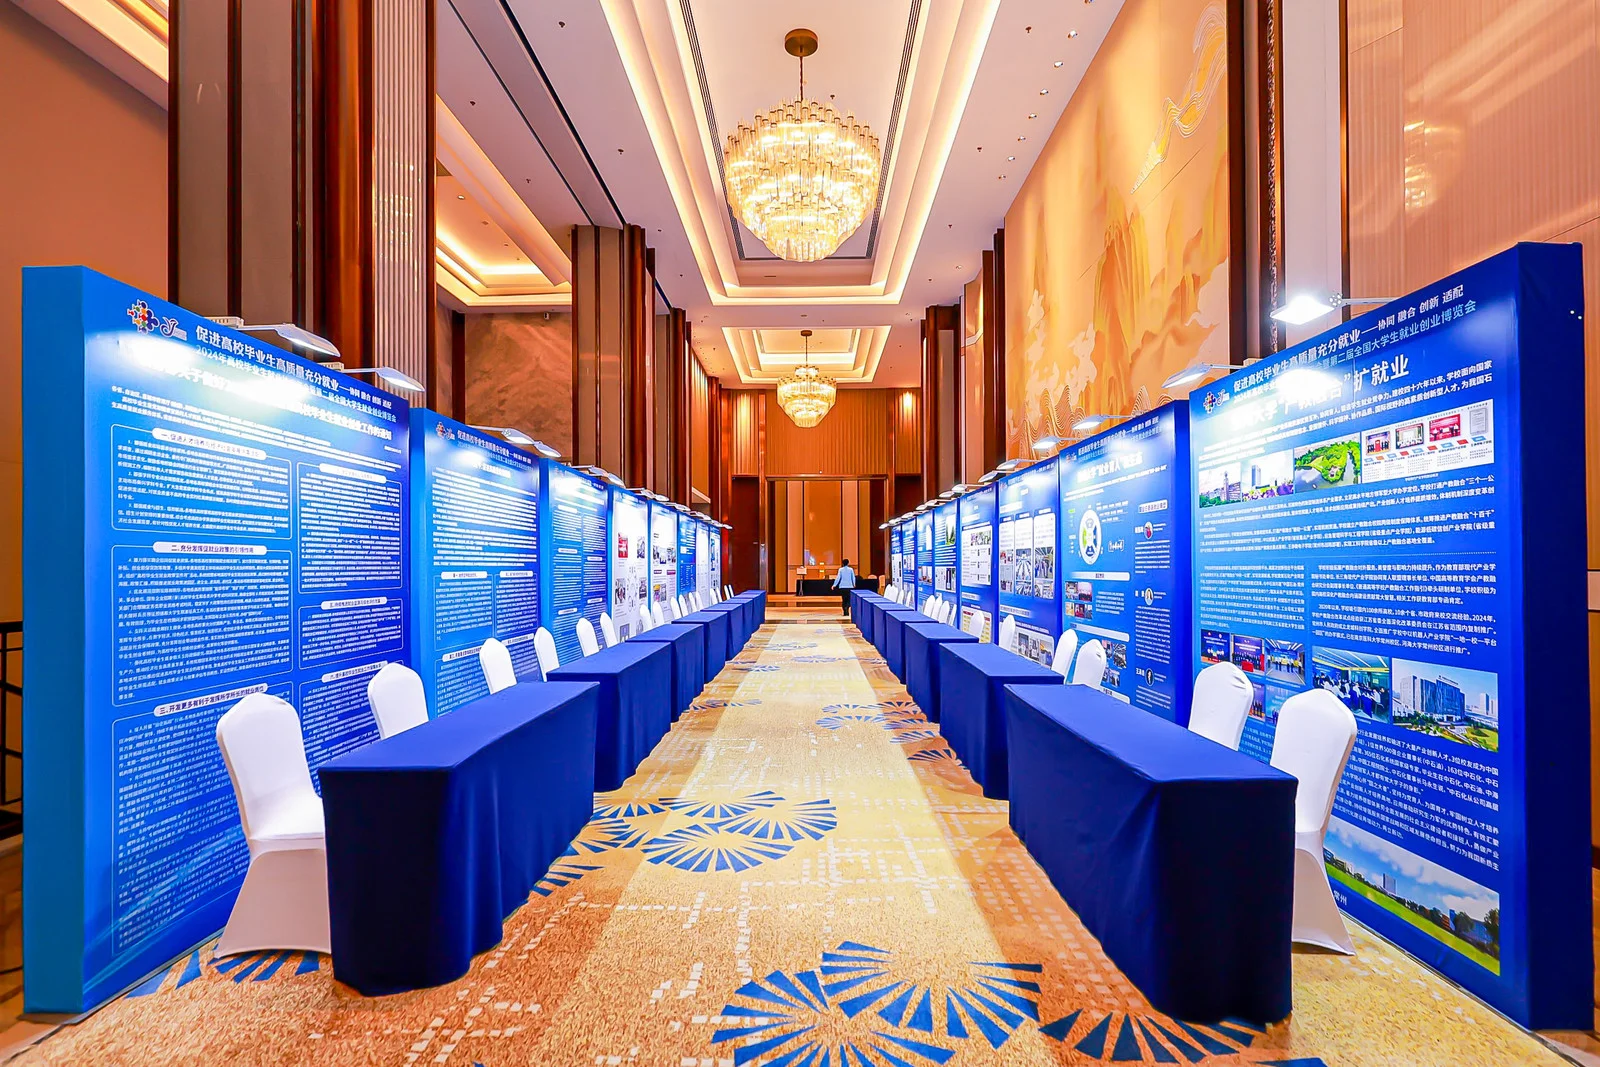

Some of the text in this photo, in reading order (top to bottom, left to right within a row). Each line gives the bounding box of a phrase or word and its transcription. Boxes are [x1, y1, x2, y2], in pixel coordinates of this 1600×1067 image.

[1398, 305, 1415, 322] 融合
[1419, 295, 1438, 314] 创新
[1442, 283, 1463, 304] 适配
[1233, 297, 1475, 403] 2024年高校毕业会暨第二届全国大学生就业创业博览会
